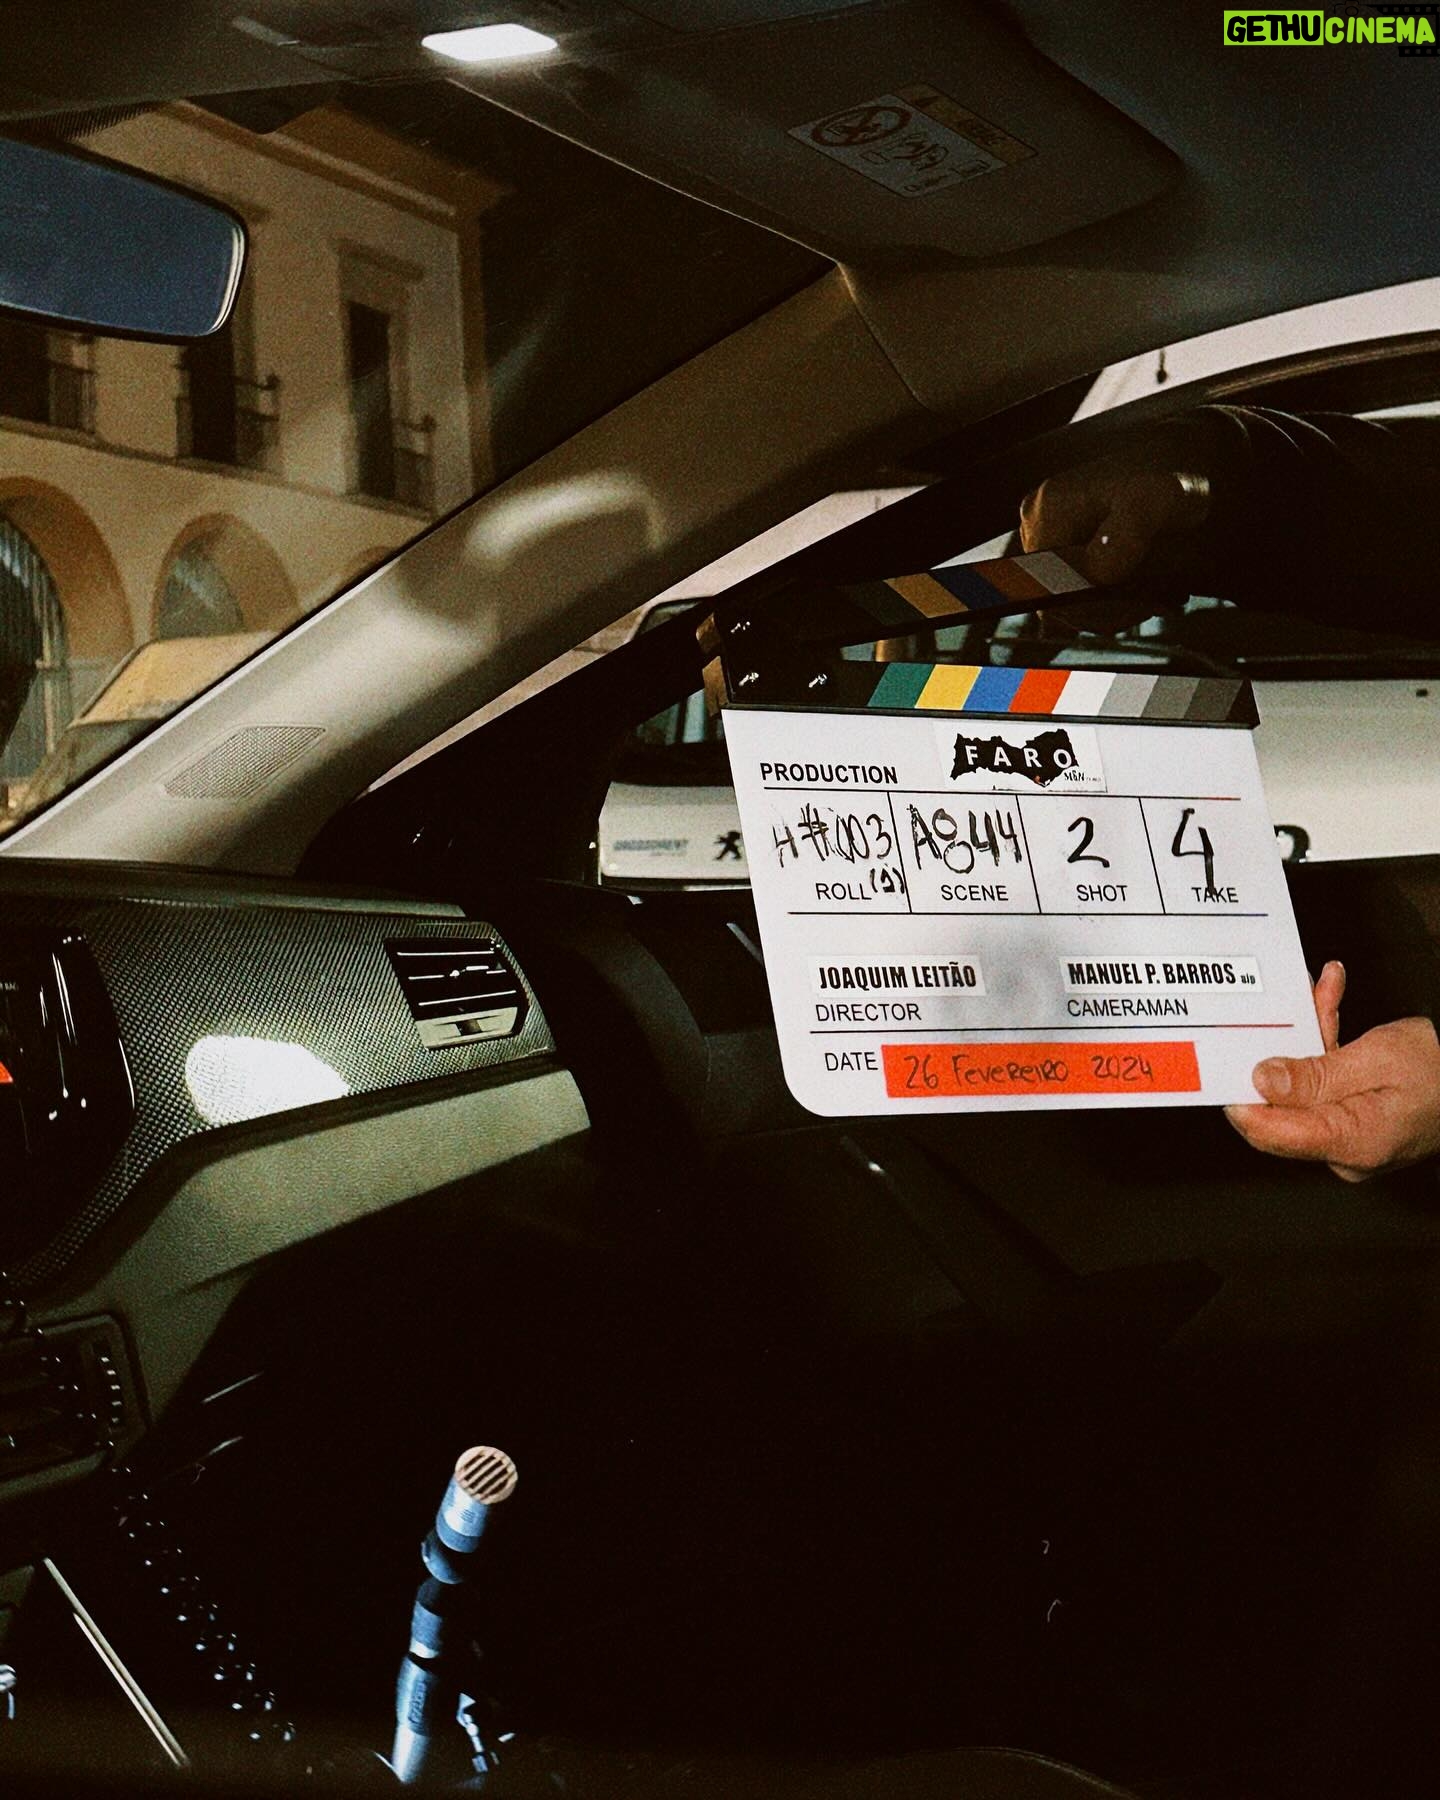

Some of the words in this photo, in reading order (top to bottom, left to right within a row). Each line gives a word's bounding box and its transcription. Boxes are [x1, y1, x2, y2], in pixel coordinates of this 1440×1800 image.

[964, 744, 1073, 769] FARO
[759, 762, 899, 785] PRODUCTION
[1067, 816, 1111, 868] 2
[1171, 807, 1215, 895] 4
[815, 882, 873, 901] ROLL
[939, 884, 1009, 901] SCENE
[1075, 884, 1128, 902] SHOT
[1190, 886, 1240, 904] TAKE
[818, 965, 909, 992] JOAQUIM
[911, 961, 978, 989] LEITÃO
[1067, 962, 1143, 985] MANUEL
[1144, 963, 1161, 985] P.
[1162, 962, 1237, 985] BARROS
[815, 1002, 922, 1022] DIRECTOR
[1067, 998, 1189, 1017] CAMERAMAN
[824, 1051, 879, 1072] DATE
[903, 1054, 939, 1090] 26
[1090, 1054, 1154, 1083] 2024
